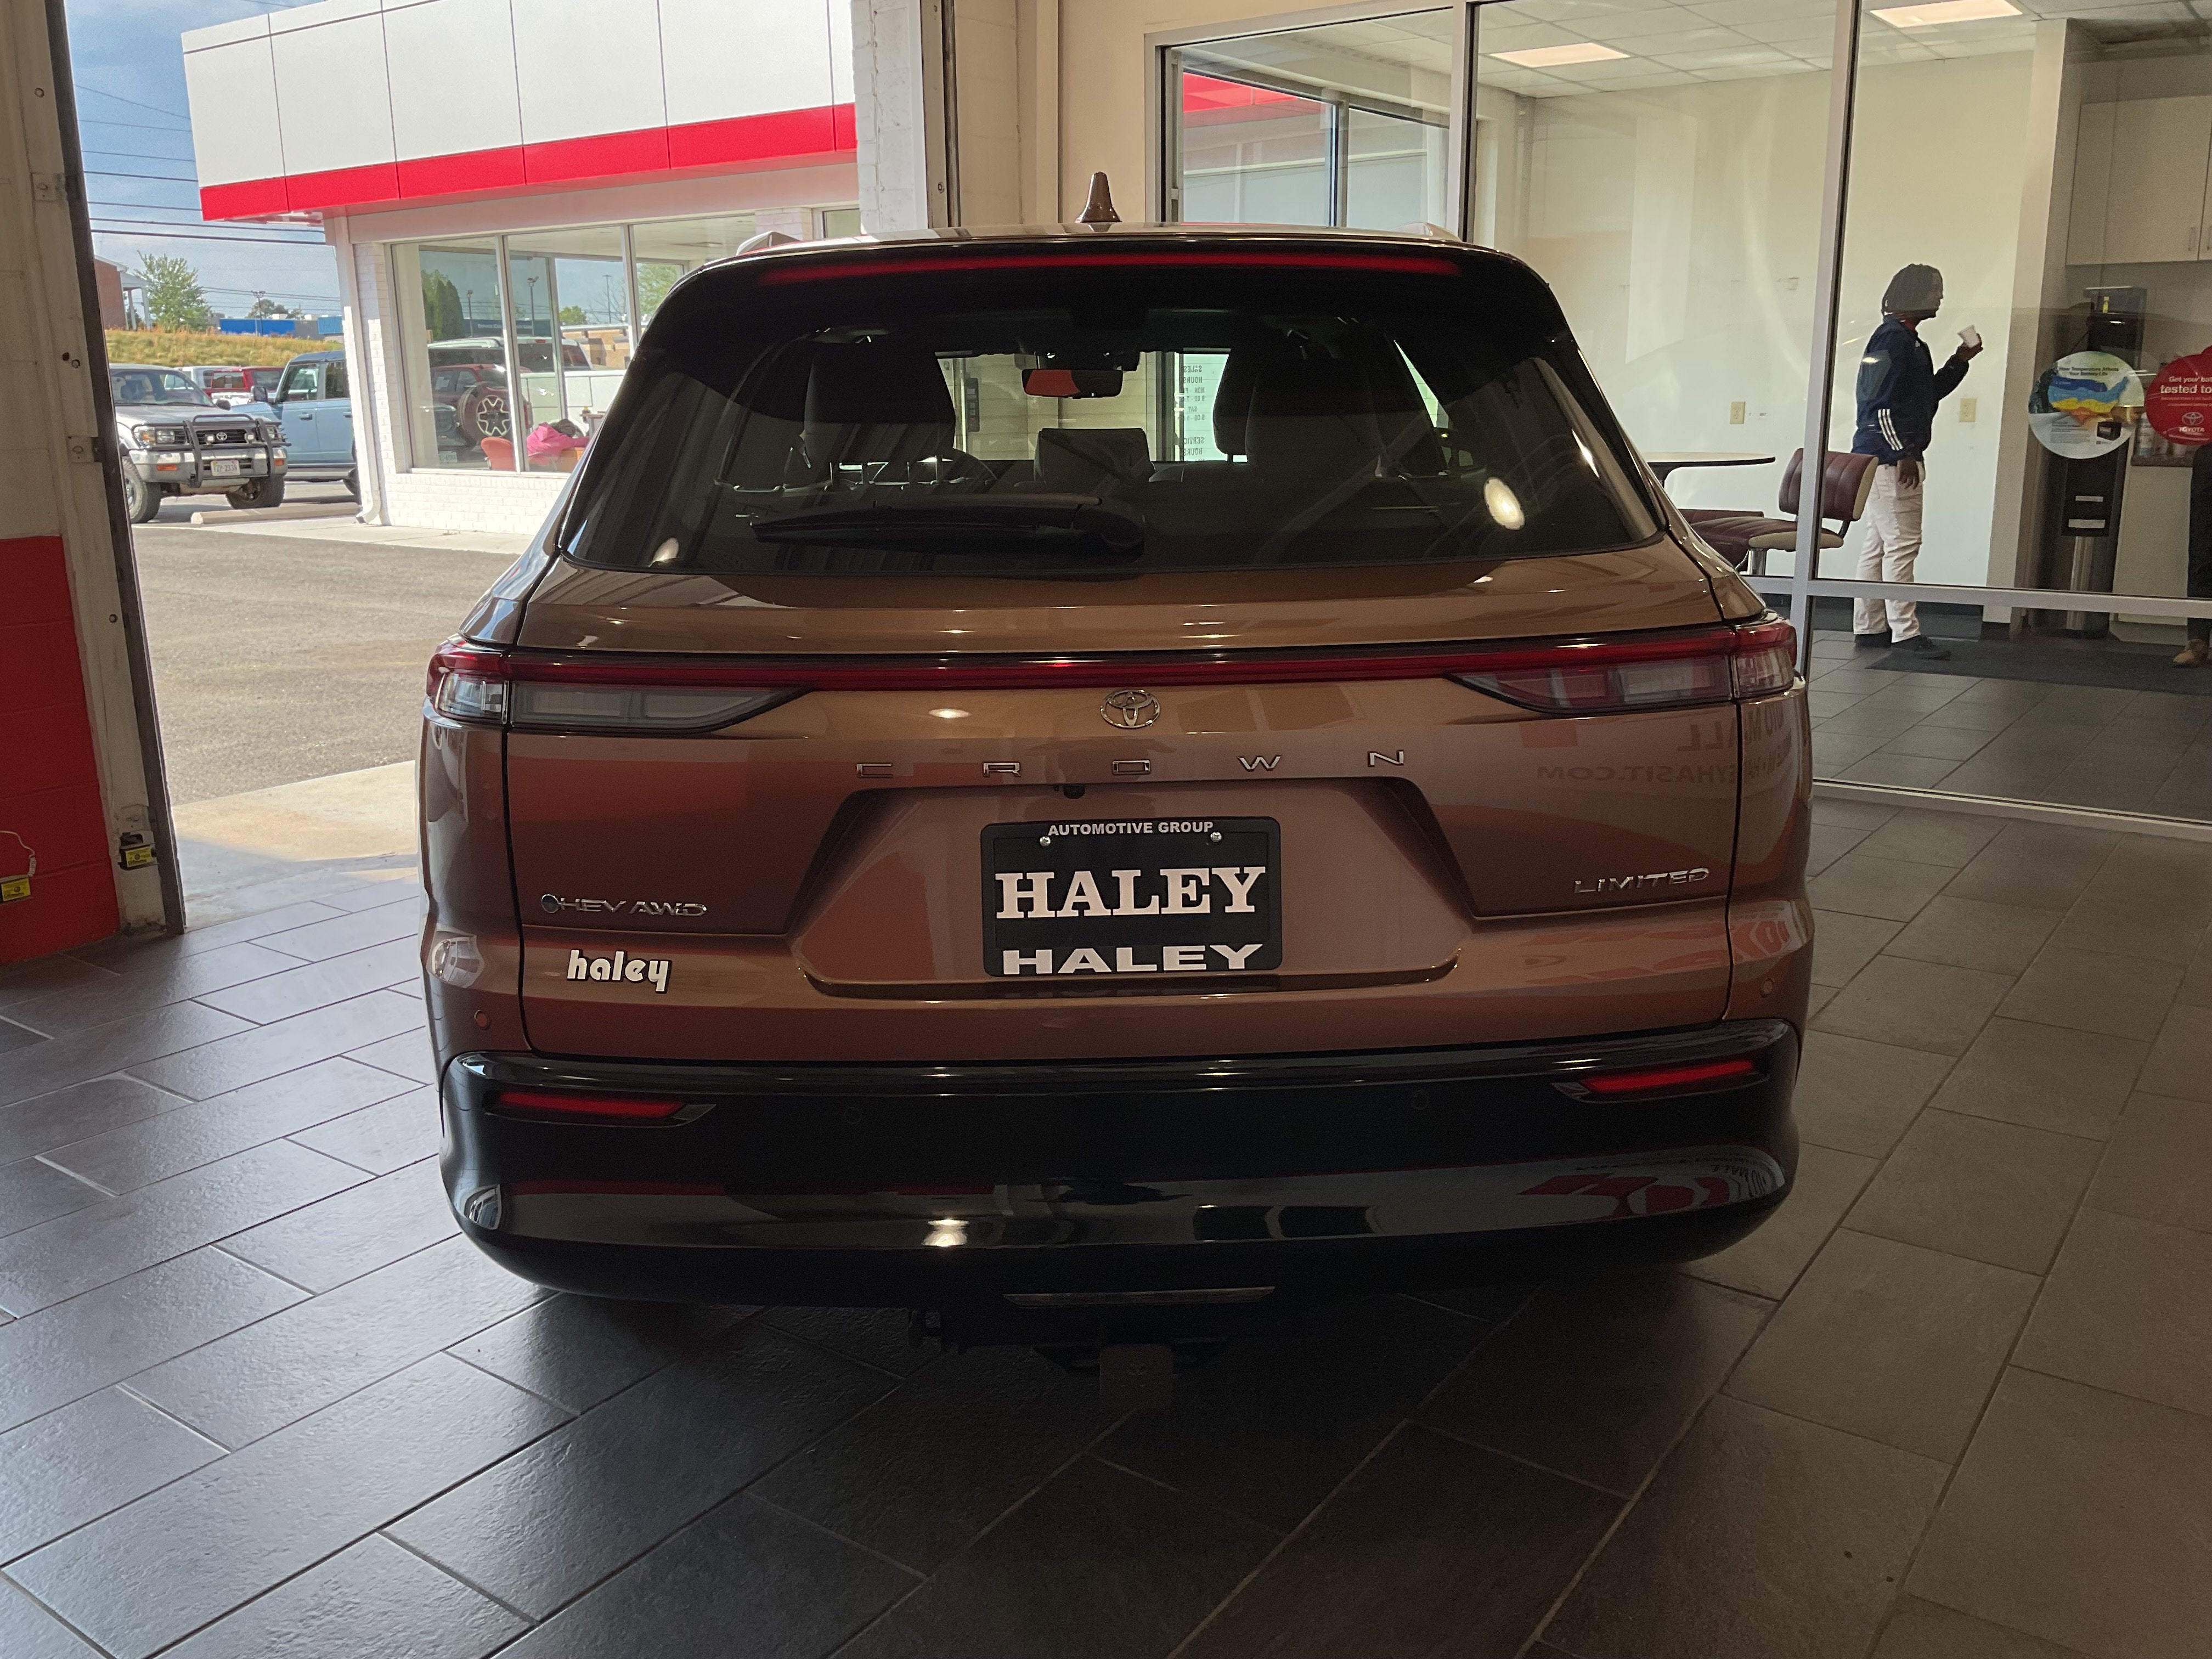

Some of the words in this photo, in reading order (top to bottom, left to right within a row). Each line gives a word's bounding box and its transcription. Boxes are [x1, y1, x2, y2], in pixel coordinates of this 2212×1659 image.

[2160, 384, 2198, 394] tested
[856, 749, 1404, 779] CROWN
[1048, 822, 1153, 837] AUTOMOTIVE
[1158, 821, 1214, 833] GROUP
[995, 866, 1266, 919] HALEY
[1574, 867, 1710, 894] LIMITED
[560, 896, 627, 913] HEV
[629, 901, 707, 916] AWD
[567, 949, 670, 992] haley
[1003, 944, 1263, 975] HALEY
